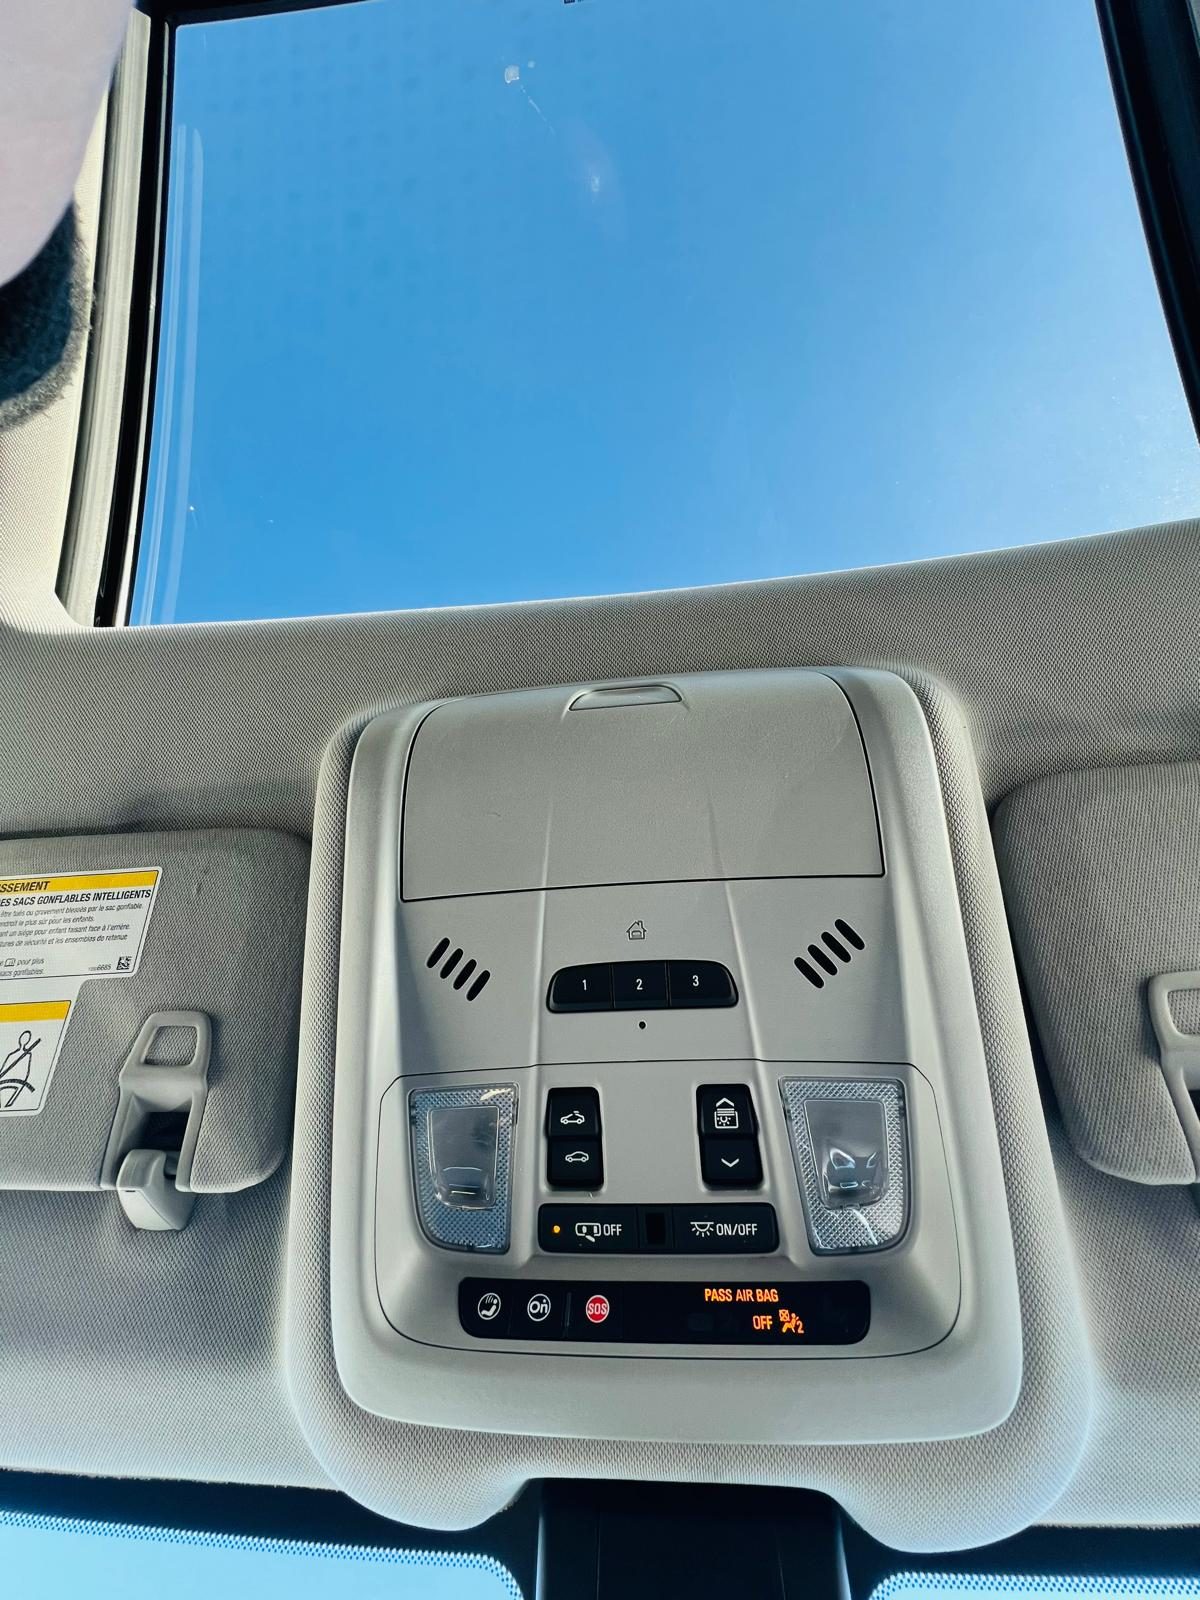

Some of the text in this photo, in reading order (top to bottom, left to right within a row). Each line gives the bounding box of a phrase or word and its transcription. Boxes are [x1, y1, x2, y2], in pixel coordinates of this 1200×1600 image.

[13, 896, 36, 906] SACS
[37, 893, 91, 904] GONFLABLES
[92, 890, 152, 901] INTELLIGENTS
[582, 975, 700, 990] 1 2 3
[603, 1224, 622, 1236] OFF
[716, 1223, 758, 1236] ON/OFF
[704, 1288, 779, 1302] PASS AIR BAG
[588, 1303, 607, 1316] SOS
[752, 1316, 773, 1330] OFF
